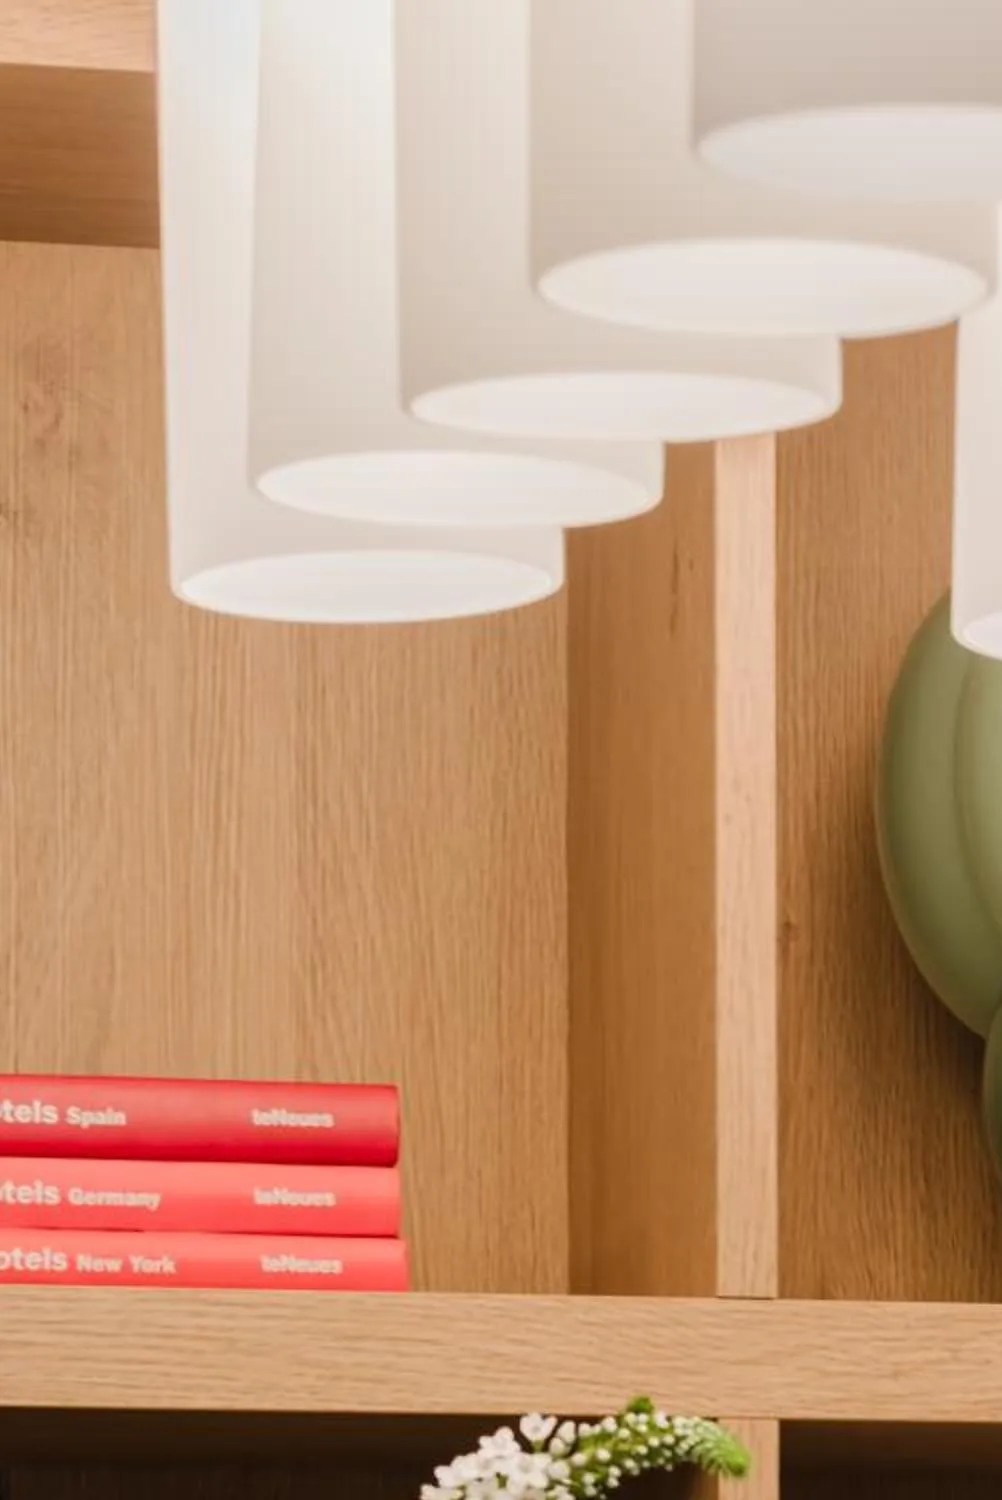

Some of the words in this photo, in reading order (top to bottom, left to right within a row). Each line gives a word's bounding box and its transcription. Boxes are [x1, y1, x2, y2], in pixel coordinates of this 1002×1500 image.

[0, 1099, 59, 1125] tels
[66, 1105, 127, 1129] Spain
[0, 1179, 61, 1206] tels
[68, 1187, 161, 1212] Germany
[76, 1254, 122, 1274] New
[129, 1255, 177, 1275] York
